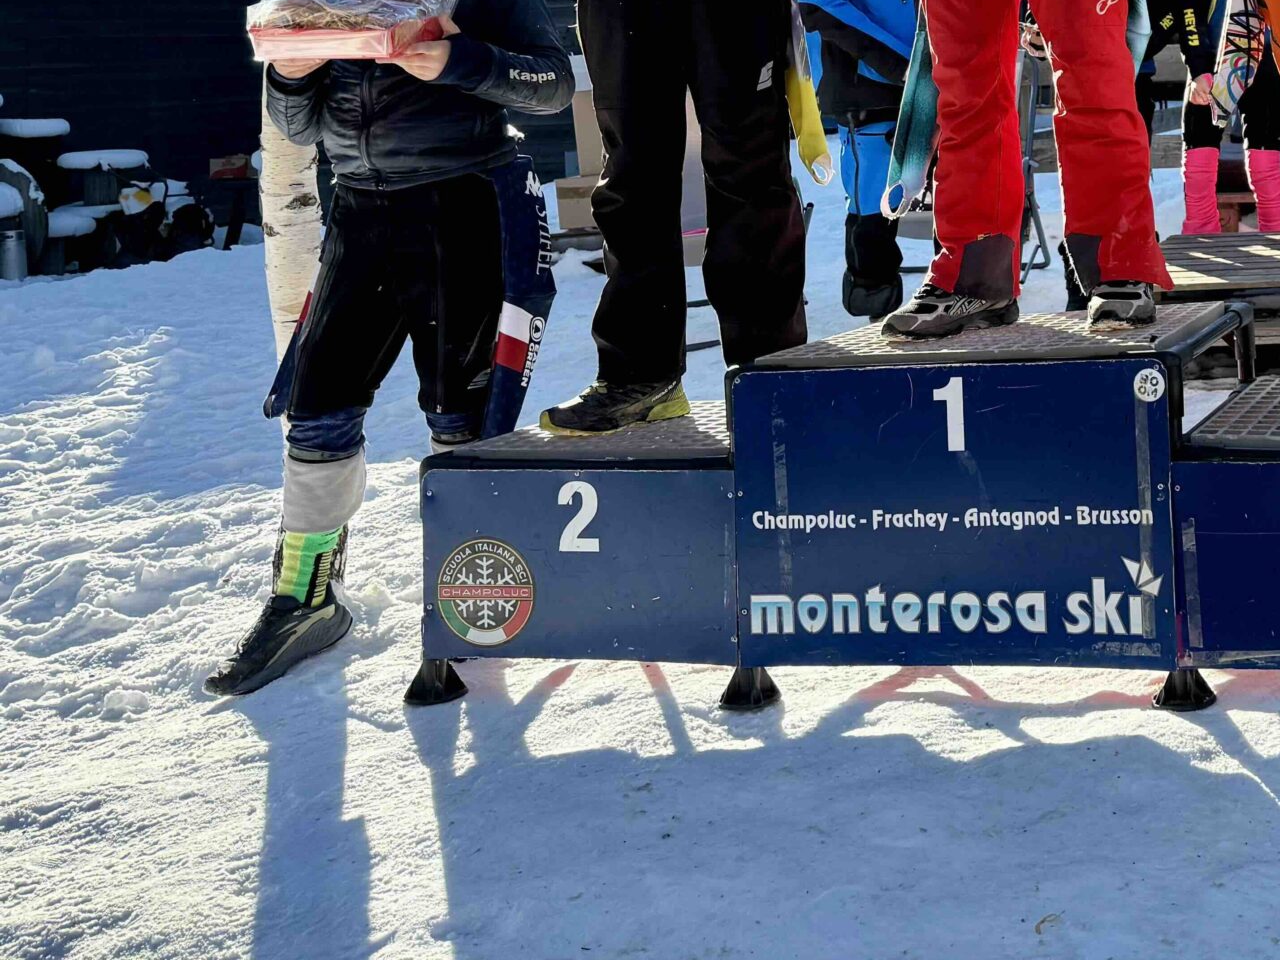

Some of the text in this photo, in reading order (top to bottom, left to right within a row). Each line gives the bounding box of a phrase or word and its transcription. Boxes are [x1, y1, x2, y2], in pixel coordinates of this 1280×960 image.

[509, 68, 556, 83] Kappa
[535, 204, 552, 276] STIFEL
[520, 343, 535, 388] GREEN
[932, 376, 965, 452] 1
[558, 481, 600, 552] 2
[752, 505, 1154, 533] Champoluc Frachey Antagnod Brusson
[443, 543, 528, 583] SCUOLA ITALIANA SCI
[442, 588, 530, 597] CHAMPOLUC
[750, 570, 1160, 637] monterosa ski
